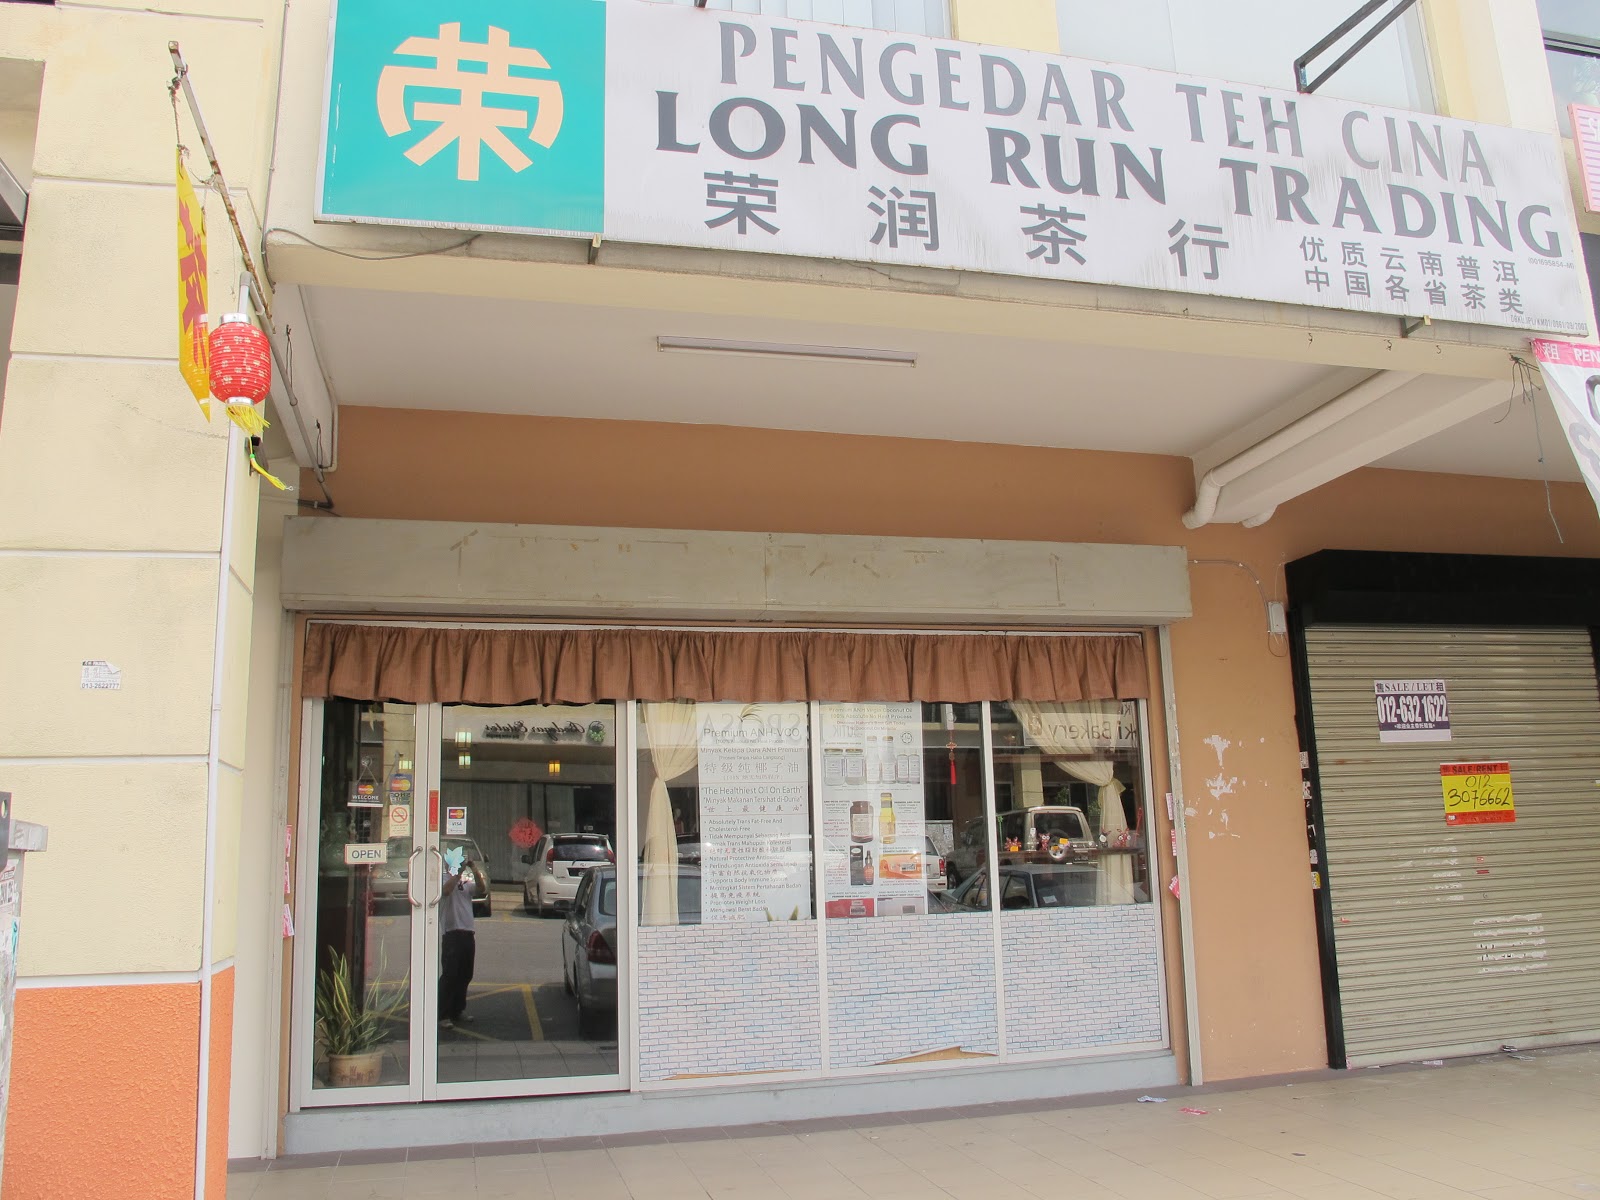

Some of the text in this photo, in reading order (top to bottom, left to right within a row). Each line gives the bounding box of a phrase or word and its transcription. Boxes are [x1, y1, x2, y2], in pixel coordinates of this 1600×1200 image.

[719, 21, 1496, 188] PENGEDAR TEH CINA
[655, 90, 1563, 259] LONG RUN TRADING
[703, 170, 1229, 281] 荣润茶行
[1299, 235, 1520, 286] 优质云南普洱
[1304, 265, 1524, 315] 中国各省茶类
[1385, 682, 1408, 692] SALE
[1417, 682, 1434, 692] LET
[1376, 694, 1449, 724] 012-632 1622
[703, 728, 748, 737] Premium
[719, 786, 756, 795] Healthiest
[769, 786, 782, 794] On
[1465, 774, 1494, 789] 012
[1448, 787, 1510, 809] 3076662
[351, 849, 382, 860] OPEN
